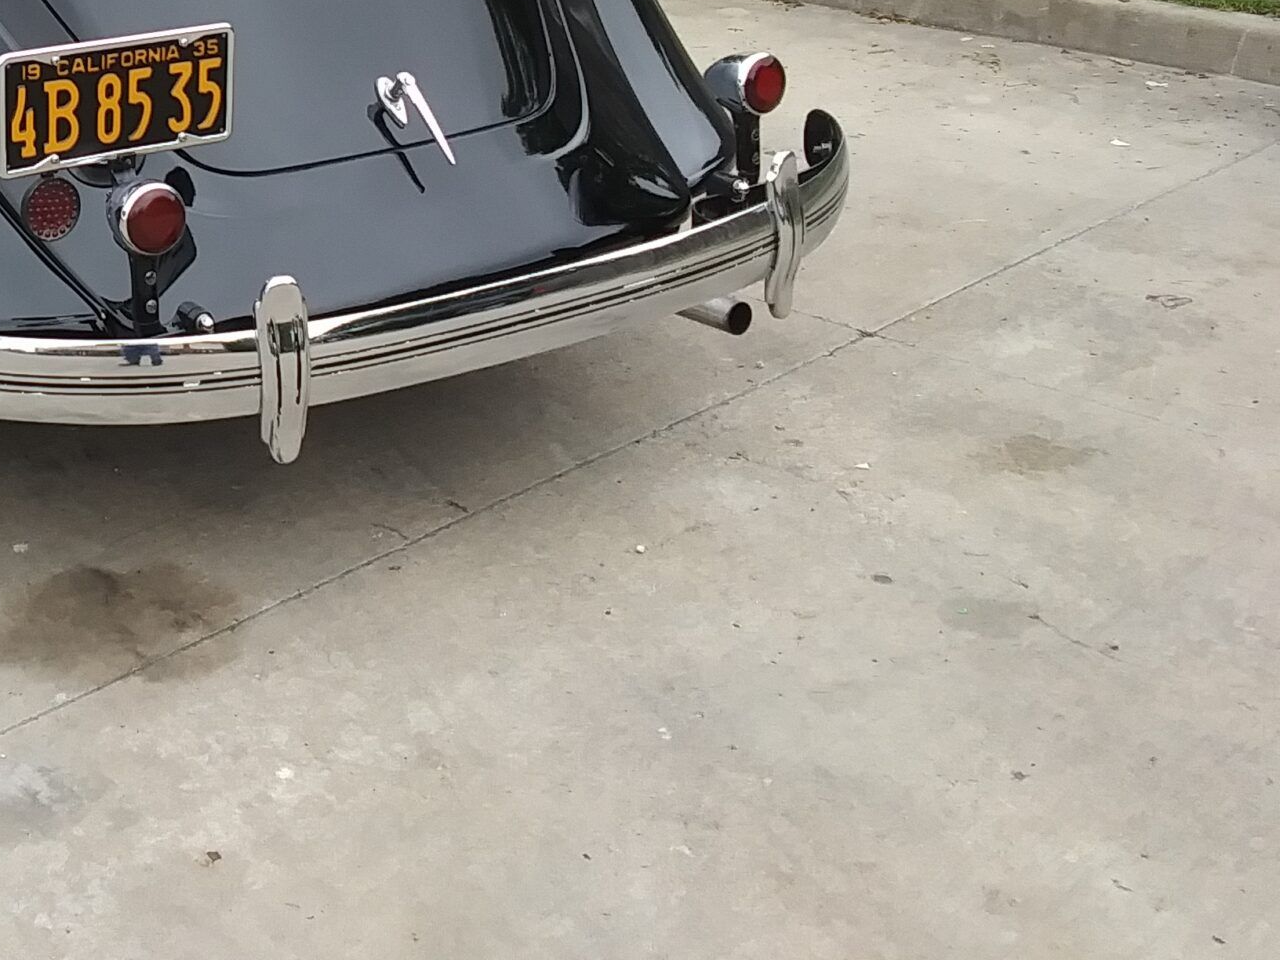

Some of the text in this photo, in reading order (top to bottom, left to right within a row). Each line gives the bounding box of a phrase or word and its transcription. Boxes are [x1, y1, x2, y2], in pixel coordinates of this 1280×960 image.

[21, 38, 219, 81] 19 CALIFORNIA 35
[11, 57, 222, 159] 4B 85 35
